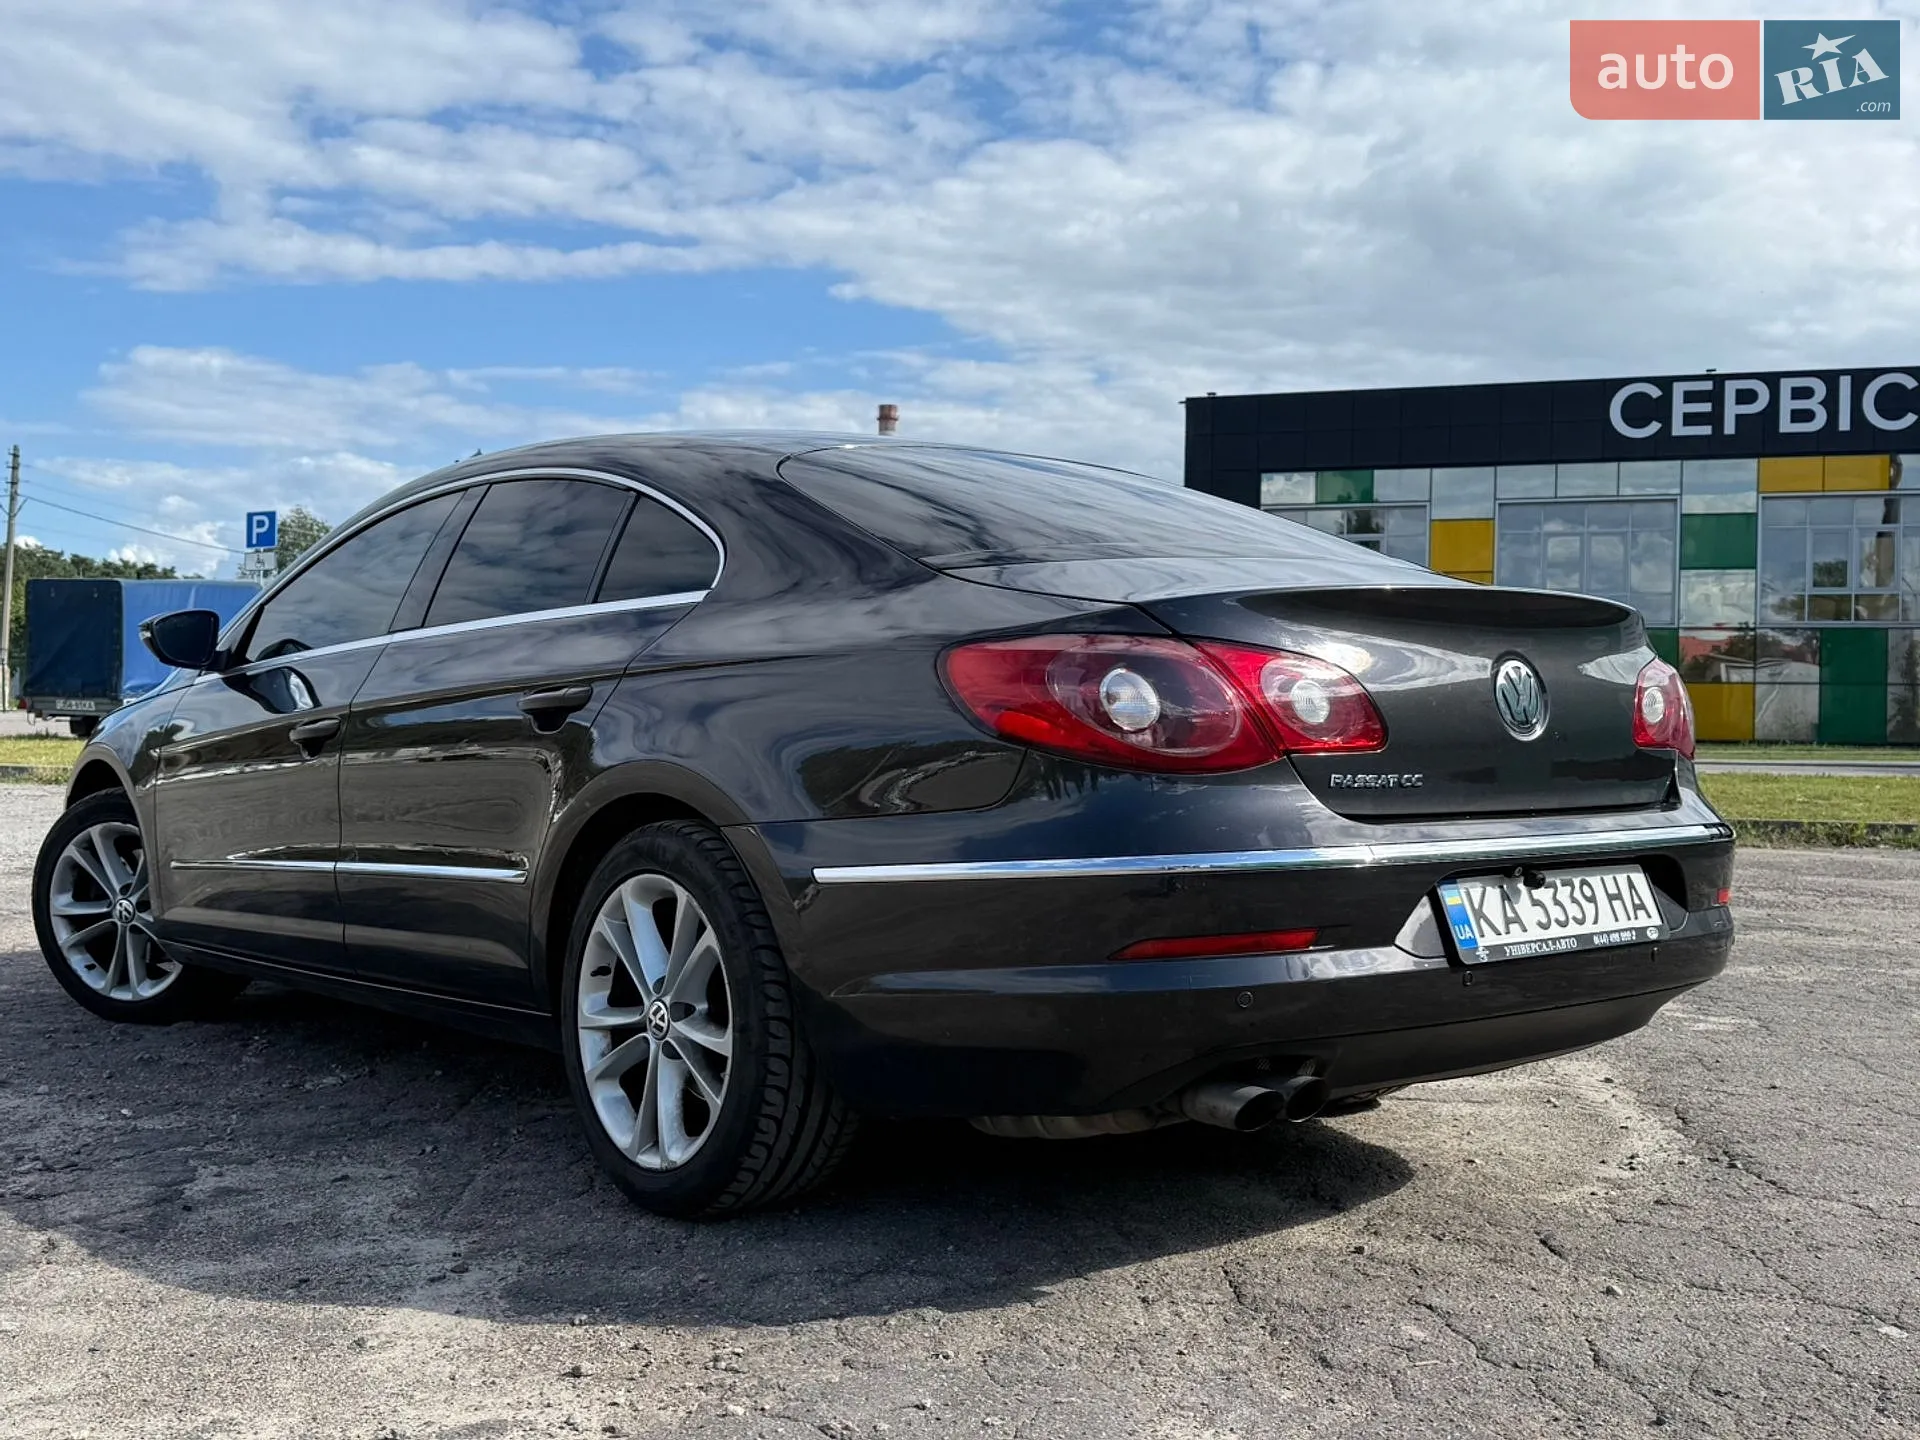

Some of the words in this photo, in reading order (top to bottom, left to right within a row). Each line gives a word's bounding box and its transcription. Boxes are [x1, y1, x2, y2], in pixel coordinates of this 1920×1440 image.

[1609, 372, 1920, 439] СЕРВІС
[252, 515, 270, 545] P
[1329, 773, 1399, 788] PASSAT
[1400, 773, 1424, 788] CC
[1464, 884, 1528, 938] KA
[1526, 877, 1600, 931] 5339
[1600, 874, 1652, 923] HA
[1454, 924, 1475, 940] UA
